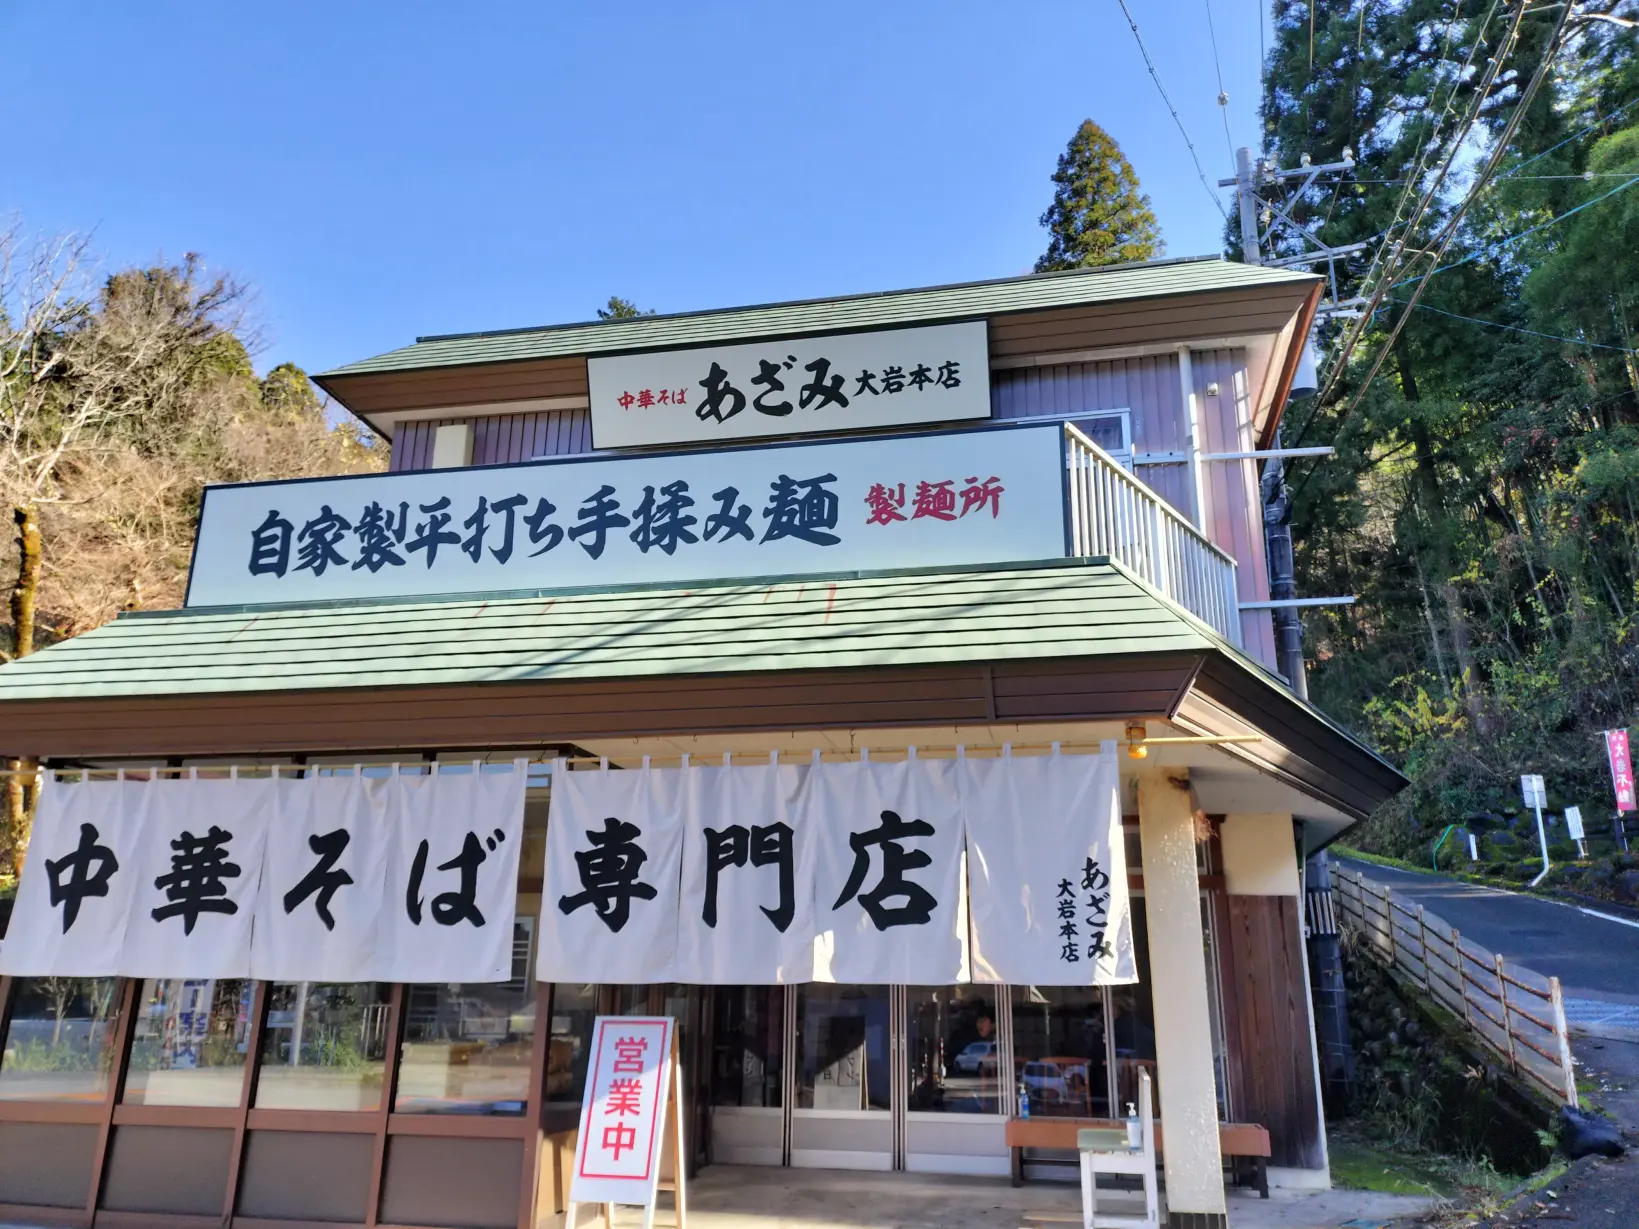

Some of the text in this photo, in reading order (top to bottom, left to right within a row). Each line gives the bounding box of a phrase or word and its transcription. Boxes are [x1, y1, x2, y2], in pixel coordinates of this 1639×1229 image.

[616, 355, 961, 424] 中華そば あざみ 大岩本店
[249, 473, 1005, 577] 自家製平打ち手揉み麺 製麺所
[45, 810, 939, 937] 中華そば 専門店
[1056, 879, 1080, 963] 大岩本店
[1080, 857, 1114, 960] あざみ
[601, 1036, 649, 1162] 営業中
